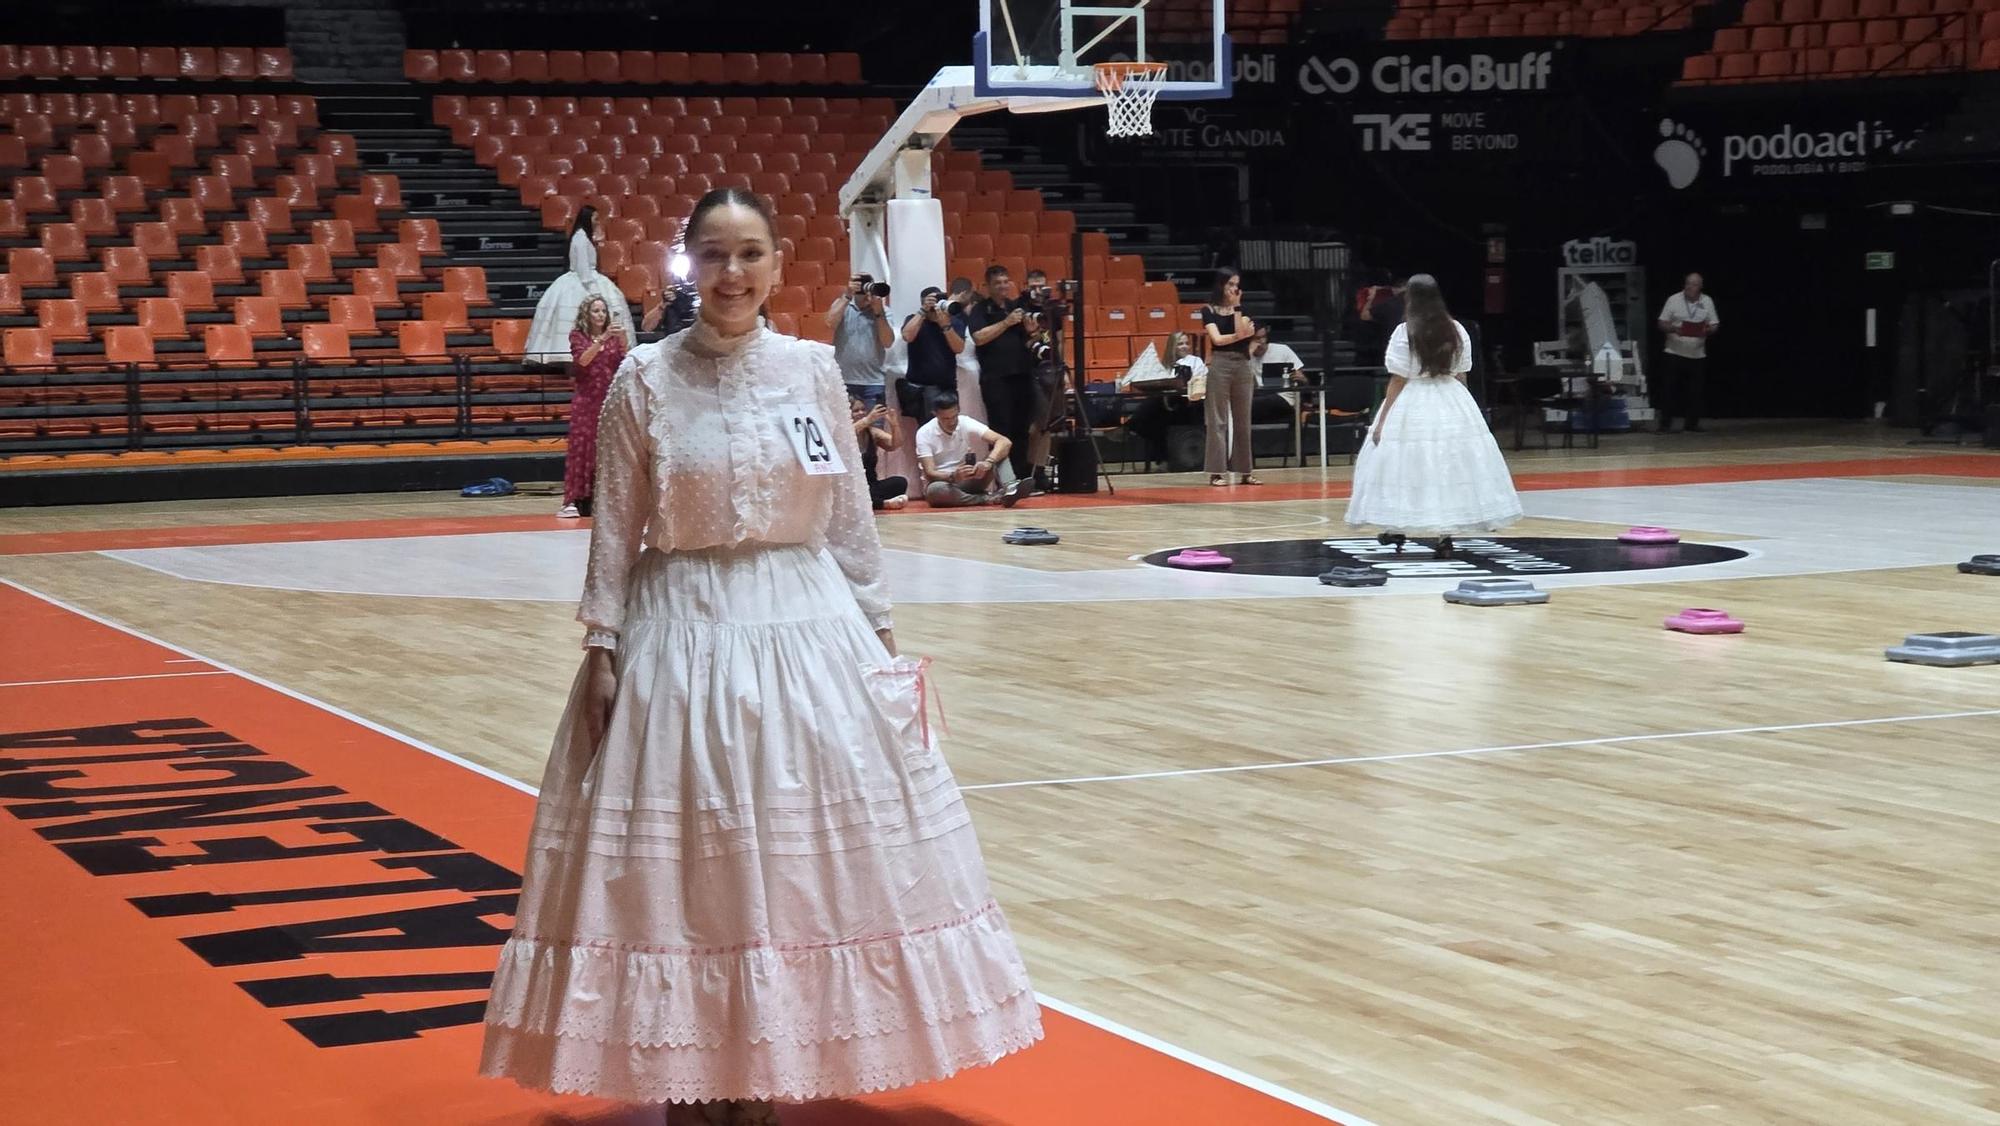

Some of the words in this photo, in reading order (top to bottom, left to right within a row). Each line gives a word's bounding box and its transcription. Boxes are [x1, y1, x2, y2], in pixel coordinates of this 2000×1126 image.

[1372, 52, 1552, 93] CicloBuff
[1442, 112, 1486, 128] MOVE
[1353, 113, 1432, 151] TKE
[1452, 134, 1518, 151] BEYOND
[479, 237, 513, 249] Torres
[1567, 243, 1632, 265] teika
[794, 417, 830, 462] 29
